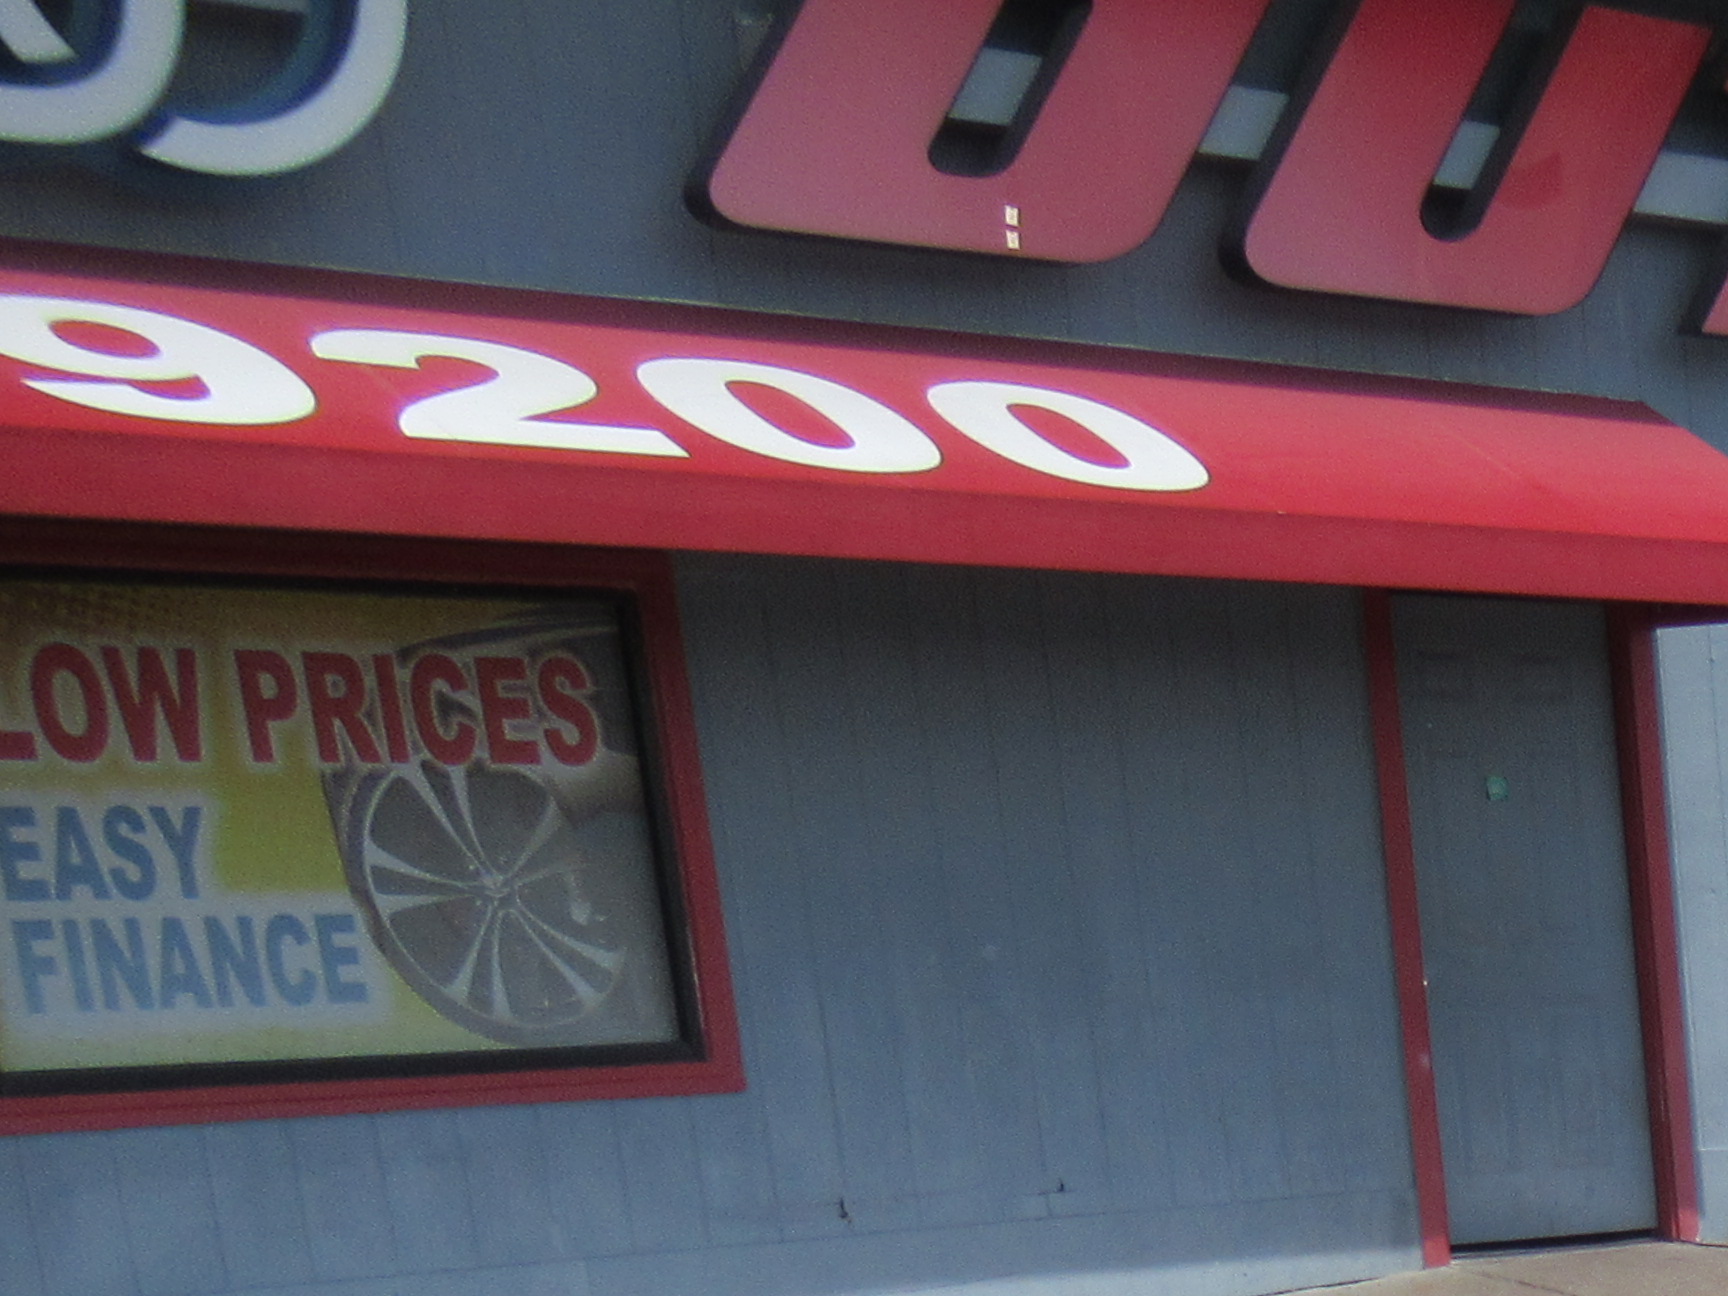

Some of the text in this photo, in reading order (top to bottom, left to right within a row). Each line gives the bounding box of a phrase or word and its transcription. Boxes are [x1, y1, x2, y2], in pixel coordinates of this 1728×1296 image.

[0, 293, 1210, 491] 9200
[232, 648, 600, 768] PRICES
[0, 804, 202, 902] EASY
[10, 912, 370, 1016] FINANCE
